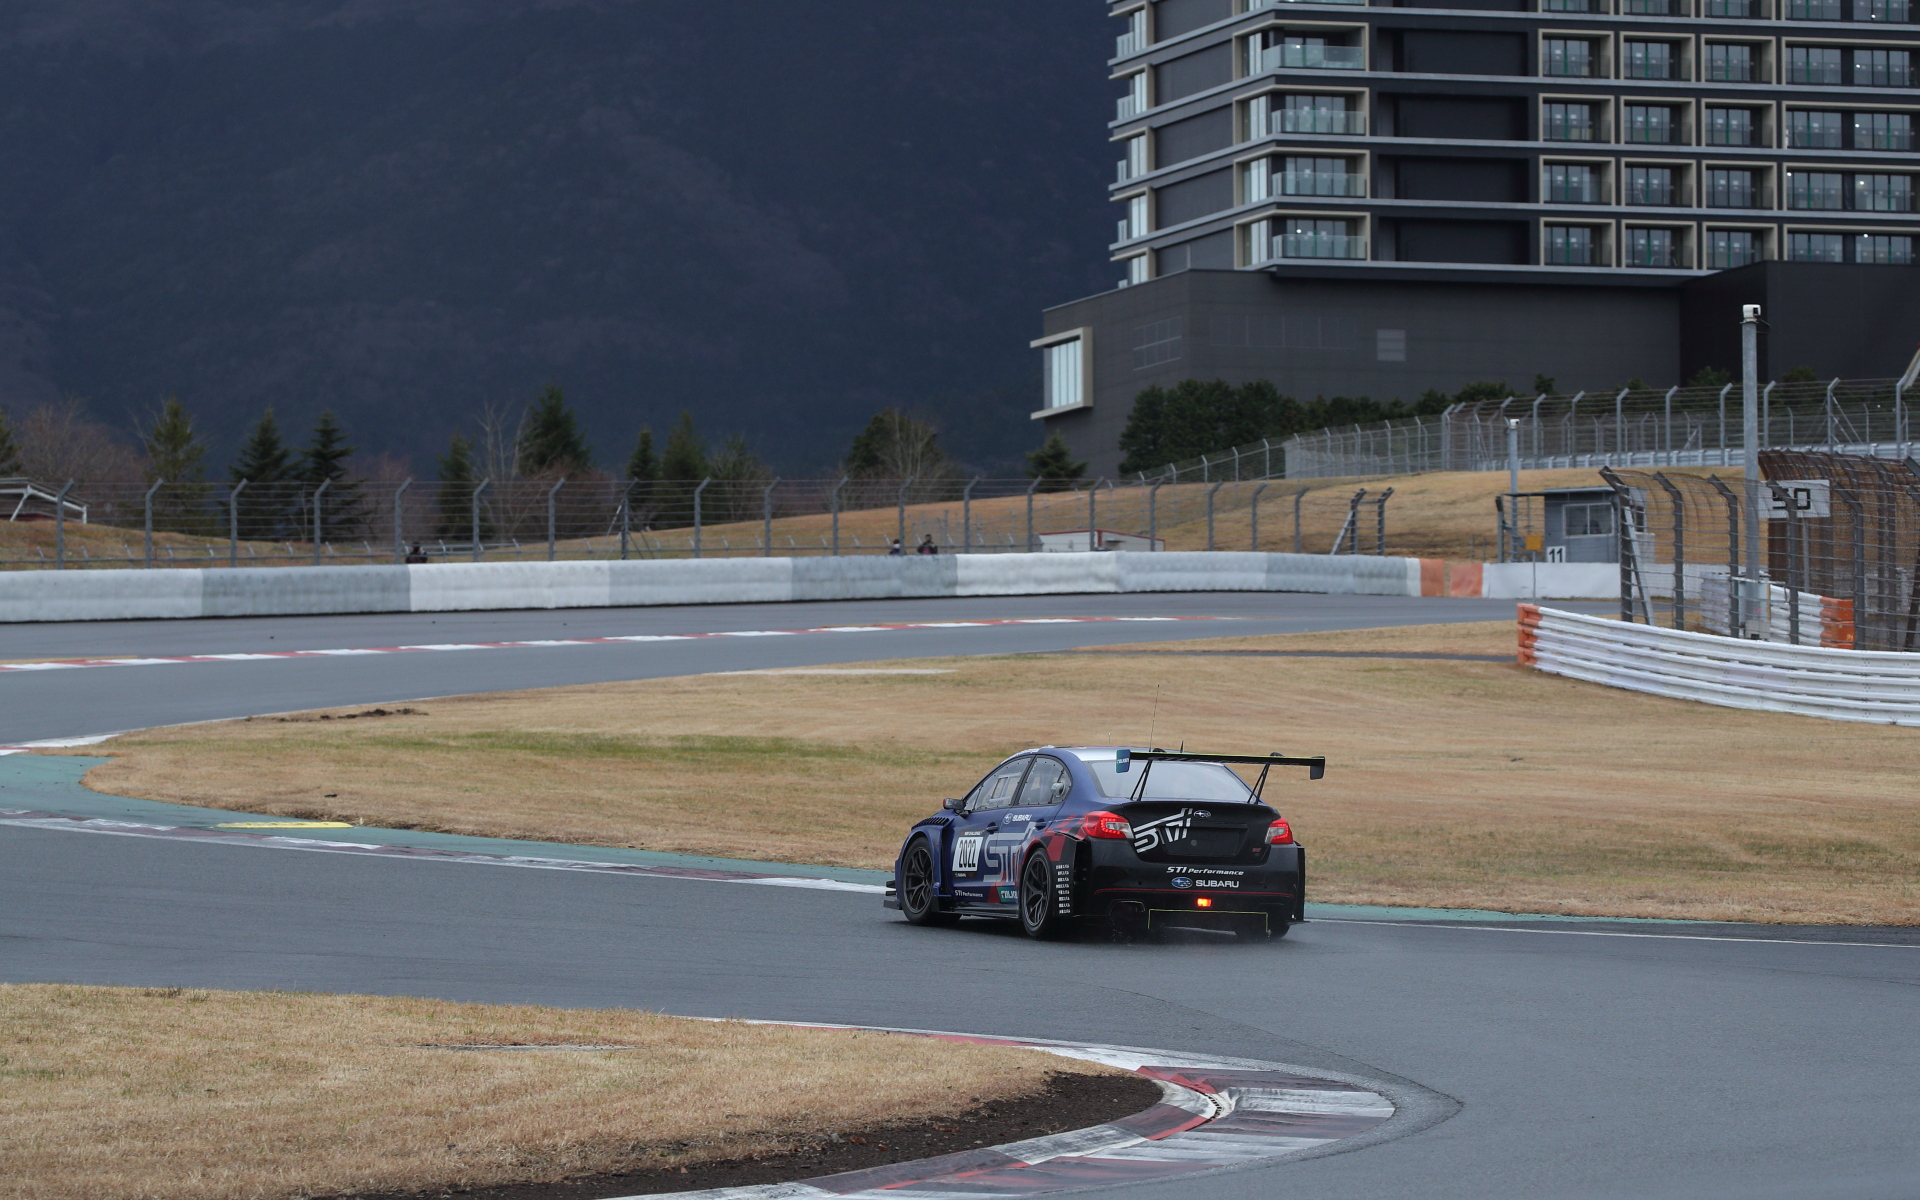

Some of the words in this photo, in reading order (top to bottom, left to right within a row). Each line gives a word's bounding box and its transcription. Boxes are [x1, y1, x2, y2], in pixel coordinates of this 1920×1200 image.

[1549, 548, 1563, 563] 11
[1012, 813, 1032, 822] SUBARU
[958, 840, 977, 868] 2022
[1166, 866, 1188, 874] STI
[1188, 868, 1244, 876] Performance
[1195, 880, 1239, 888] SUBARU
